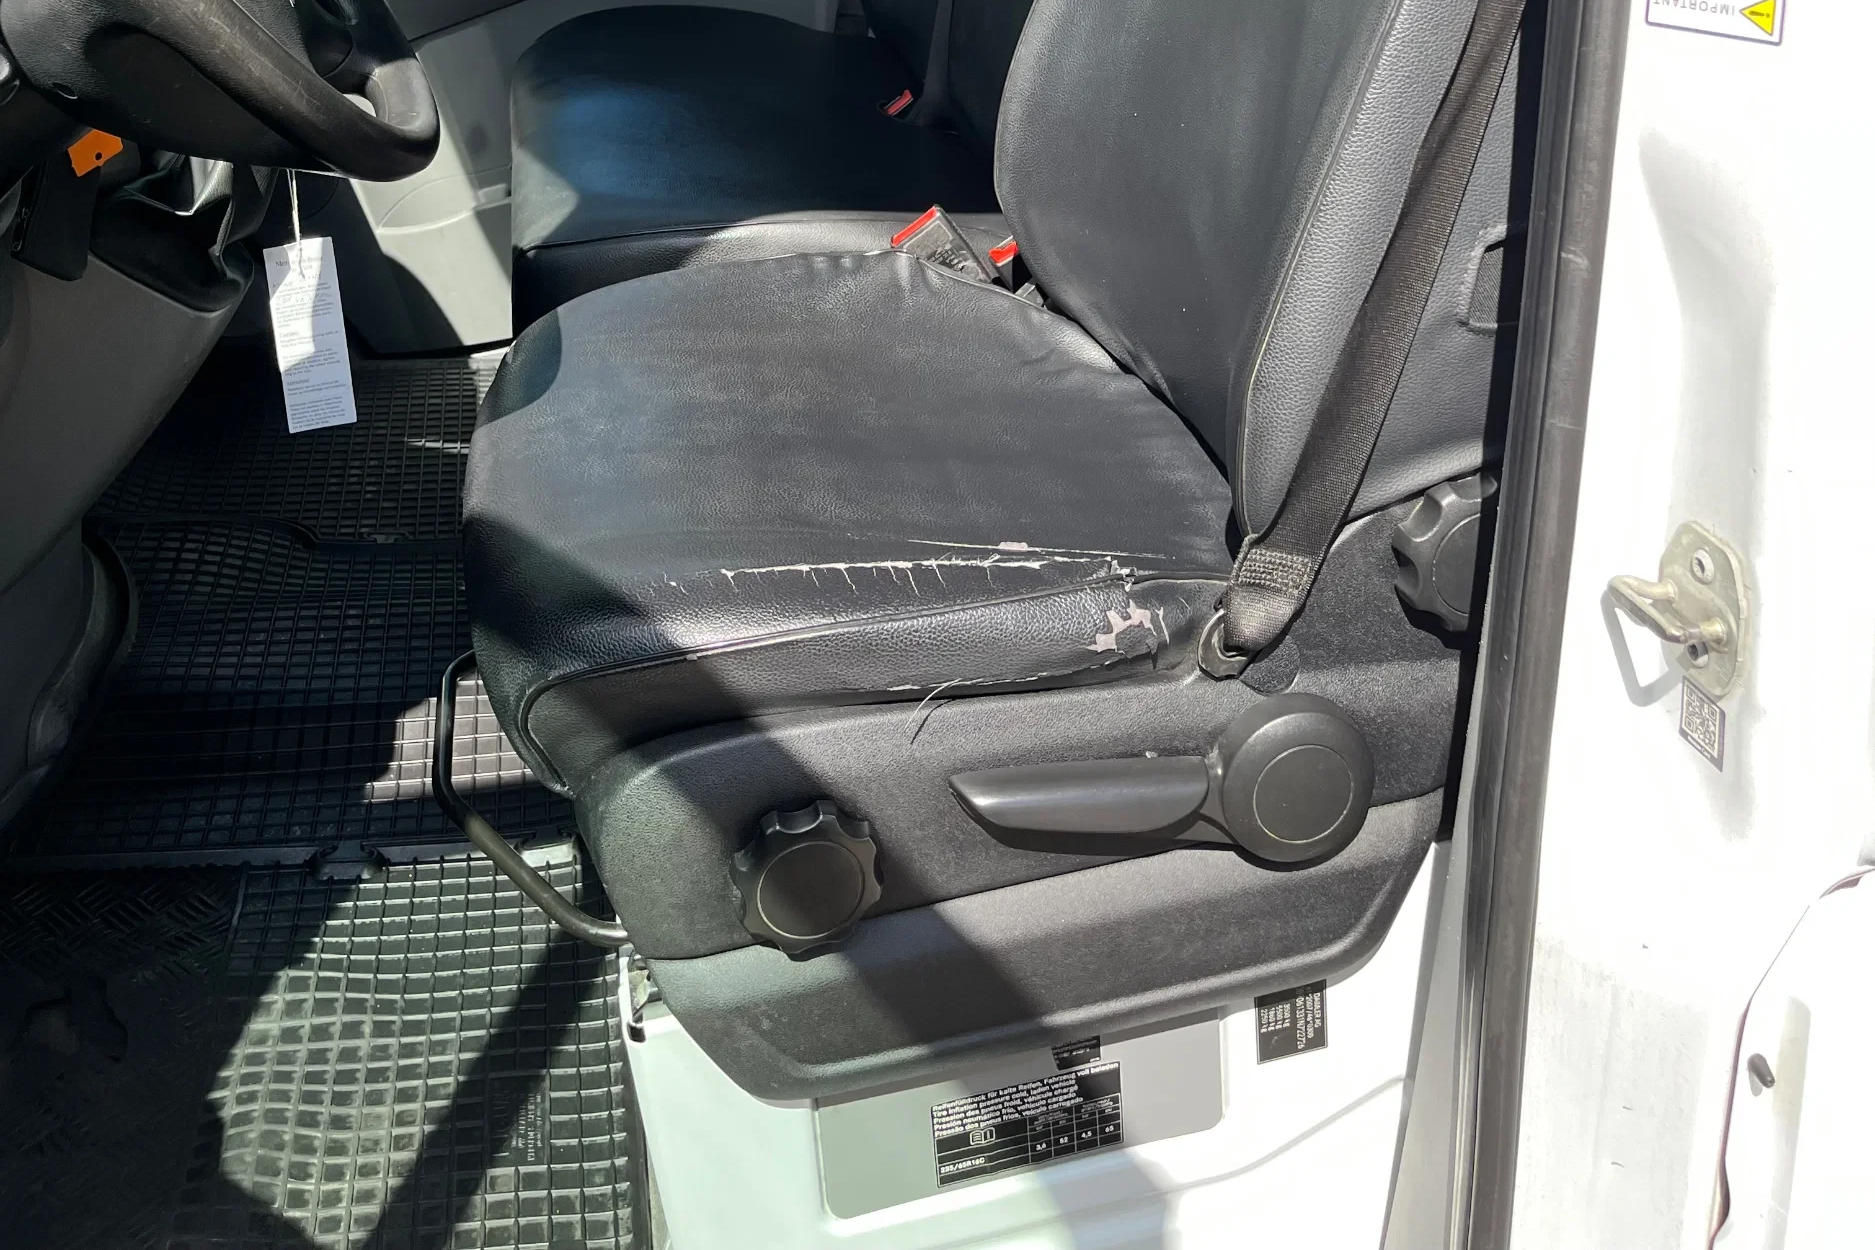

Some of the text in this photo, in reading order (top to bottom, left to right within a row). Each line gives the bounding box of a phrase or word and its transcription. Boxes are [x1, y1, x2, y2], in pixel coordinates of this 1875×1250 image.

[1314, 1018, 1320, 1027] AG
[999, 1086, 1016, 1095] kalte
[1044, 1072, 1075, 1085] Fahrzeug
[1077, 1068, 1088, 1076] voll
[1090, 1061, 1118, 1073] beladen
[933, 1109, 946, 1117] Tire
[979, 1095, 1009, 1107] pressure
[1051, 1078, 1075, 1089] vehicle
[1047, 1091, 1075, 1104] cargado
[1048, 1096, 1083, 1110] carregado
[966, 1108, 979, 1116] des
[1059, 1136, 1068, 1144] 52
[1081, 1130, 1091, 1139] 4,5
